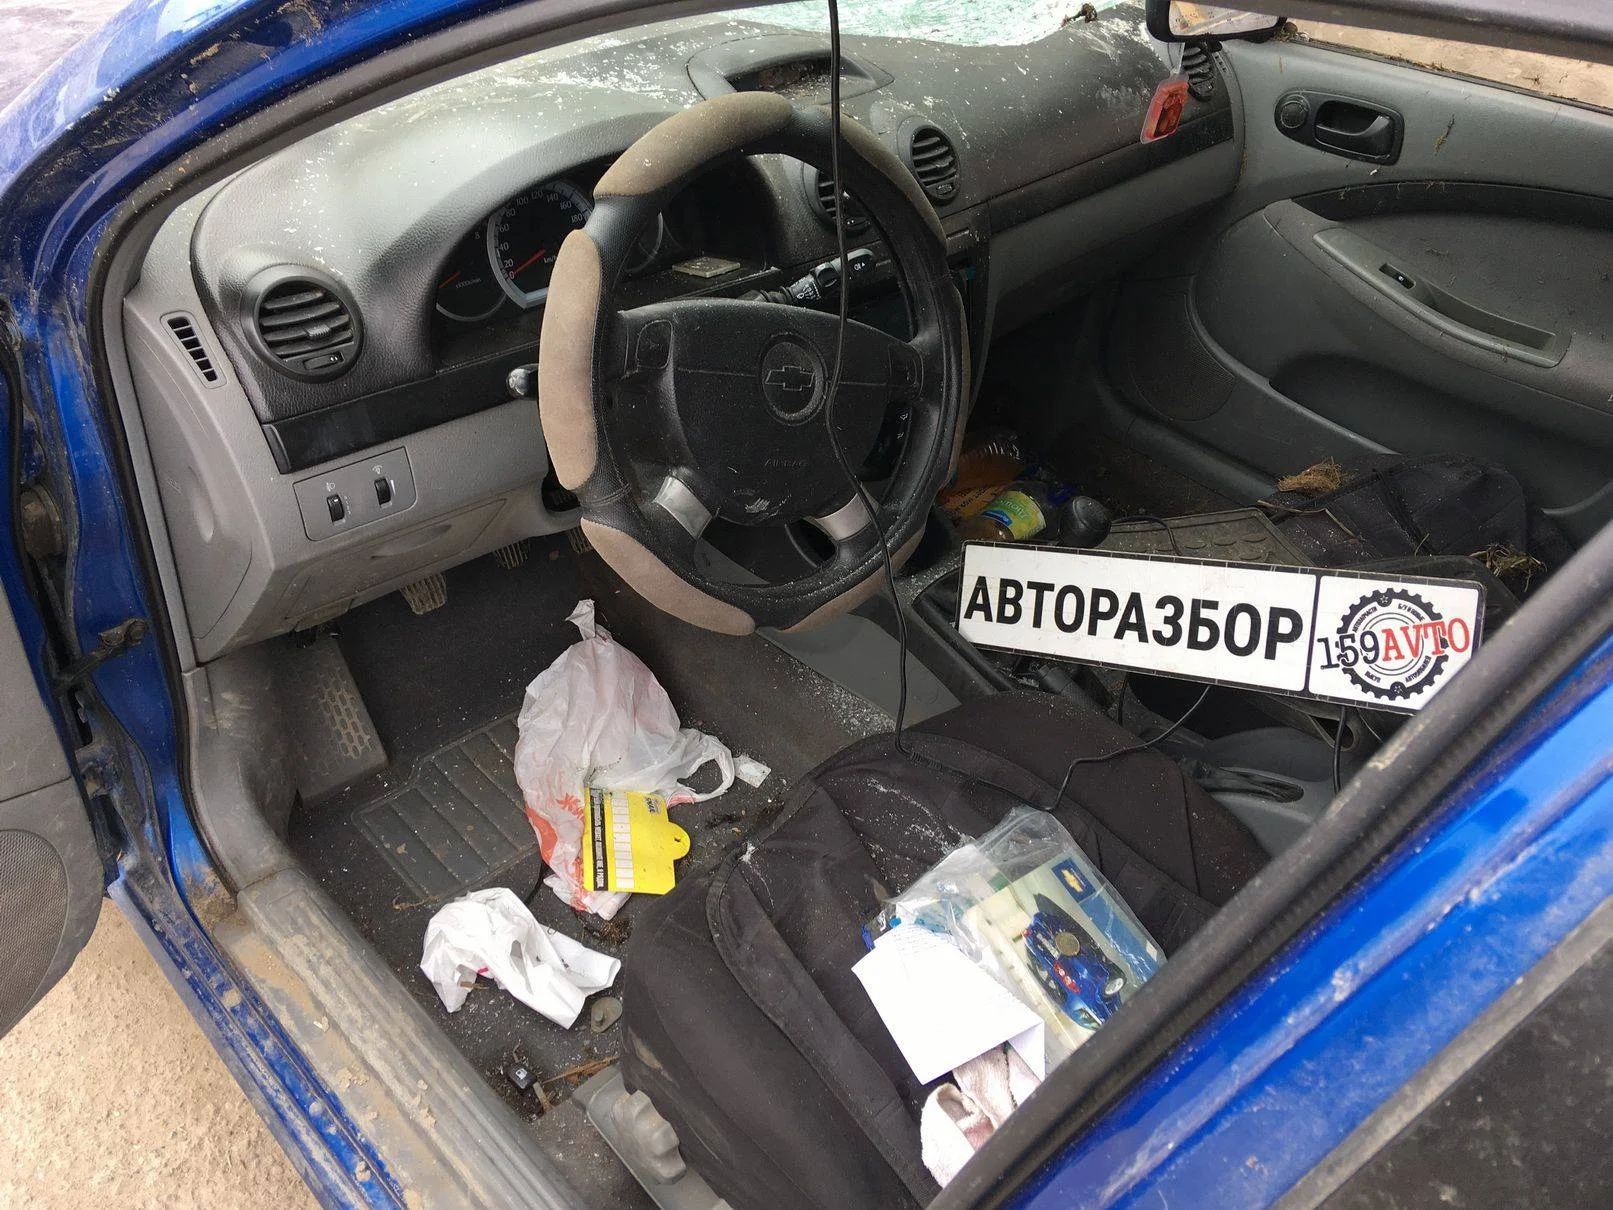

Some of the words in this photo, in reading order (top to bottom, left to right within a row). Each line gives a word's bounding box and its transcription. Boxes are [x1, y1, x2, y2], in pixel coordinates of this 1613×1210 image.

[531, 190, 543, 199] 120
[546, 193, 559, 203] 140
[516, 196, 529, 206] 100
[560, 200, 572, 210] 160
[505, 208, 516, 218] 80
[571, 213, 583, 223] 180
[500, 224, 510, 233] 60
[500, 242, 510, 252] 40
[504, 259, 514, 268] 20
[963, 575, 1305, 660] АВТОРАЗБОР
[1317, 618, 1470, 670] 159AVTO
